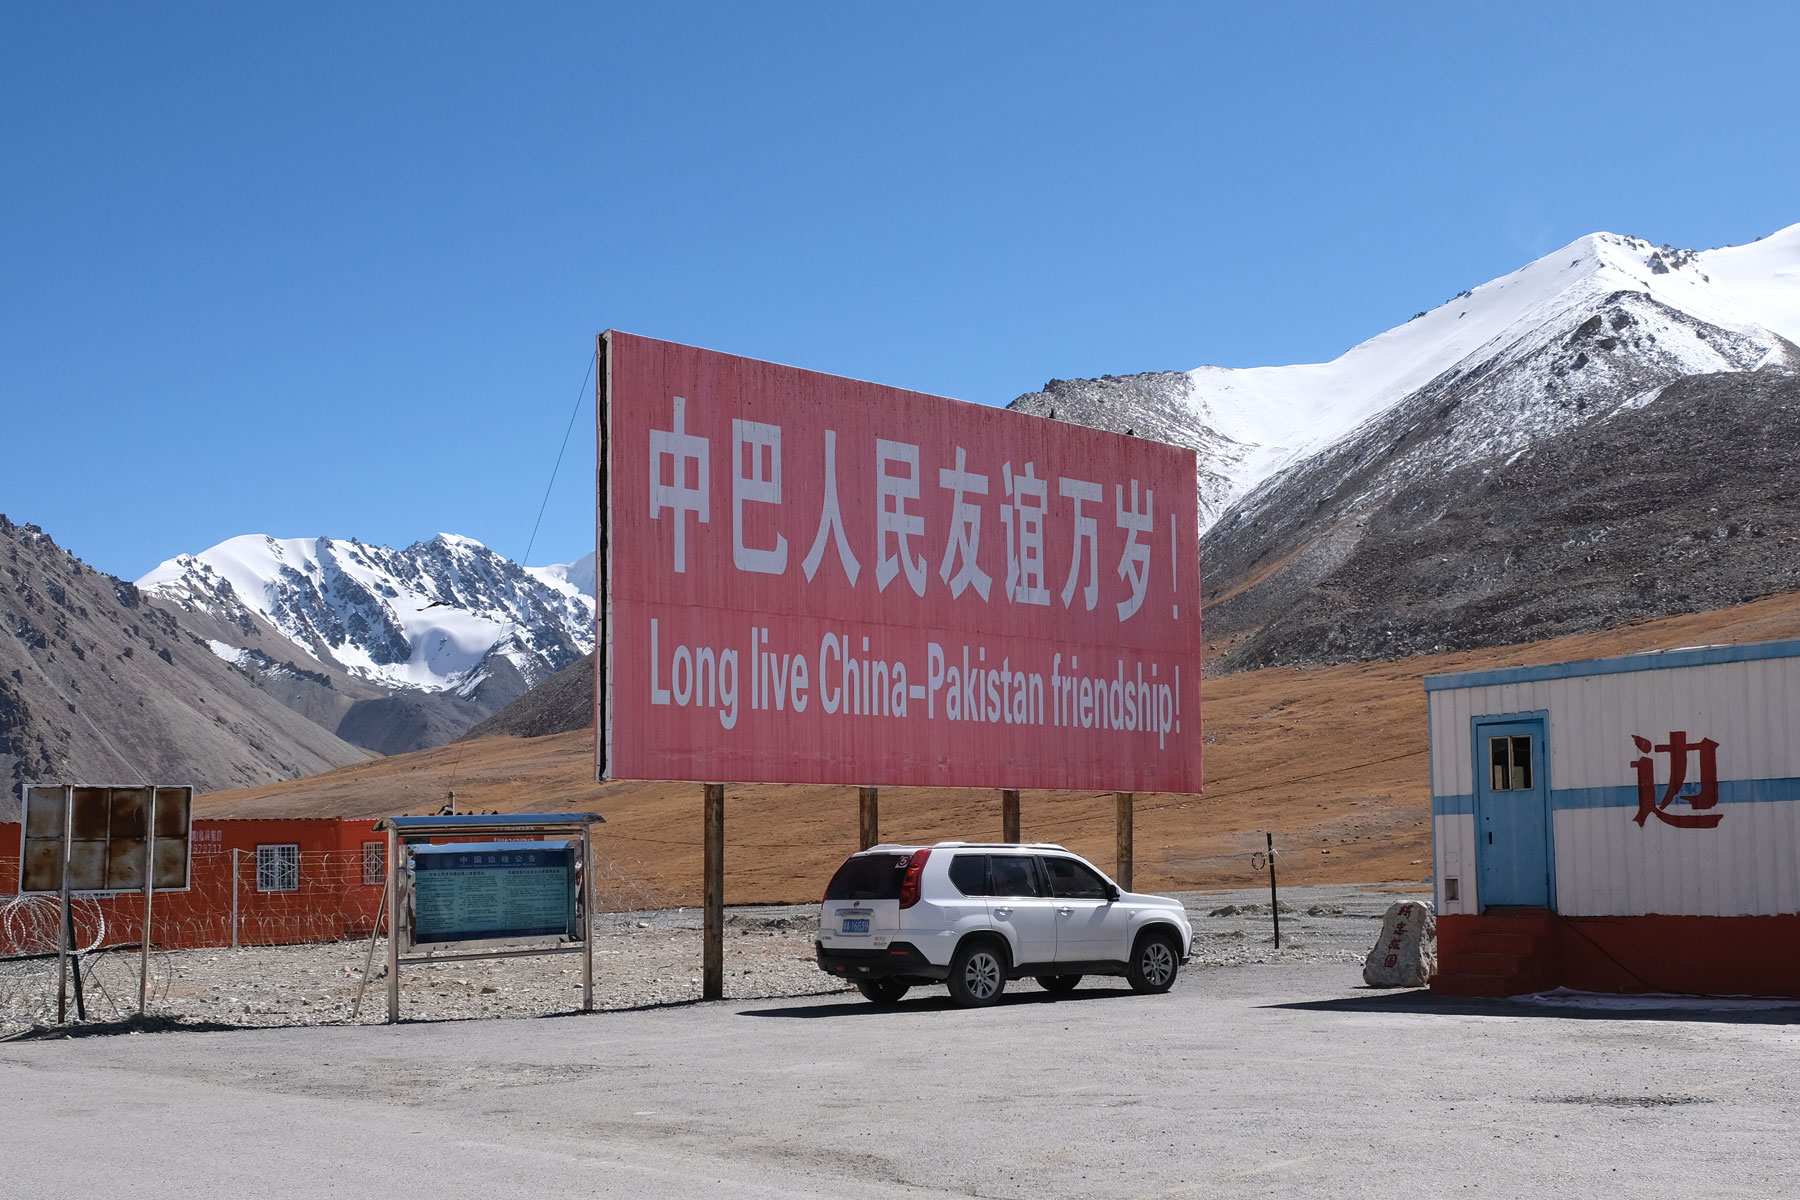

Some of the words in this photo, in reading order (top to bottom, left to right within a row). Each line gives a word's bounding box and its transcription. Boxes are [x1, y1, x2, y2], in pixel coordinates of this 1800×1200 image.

[651, 618, 738, 729] Long
[751, 626, 808, 712] live
[819, 632, 1044, 726] China-Pakistan
[1052, 652, 1180, 750] friendship!
[1630, 731, 1724, 828] 边
[459, 855, 537, 864] 中国边检公告
